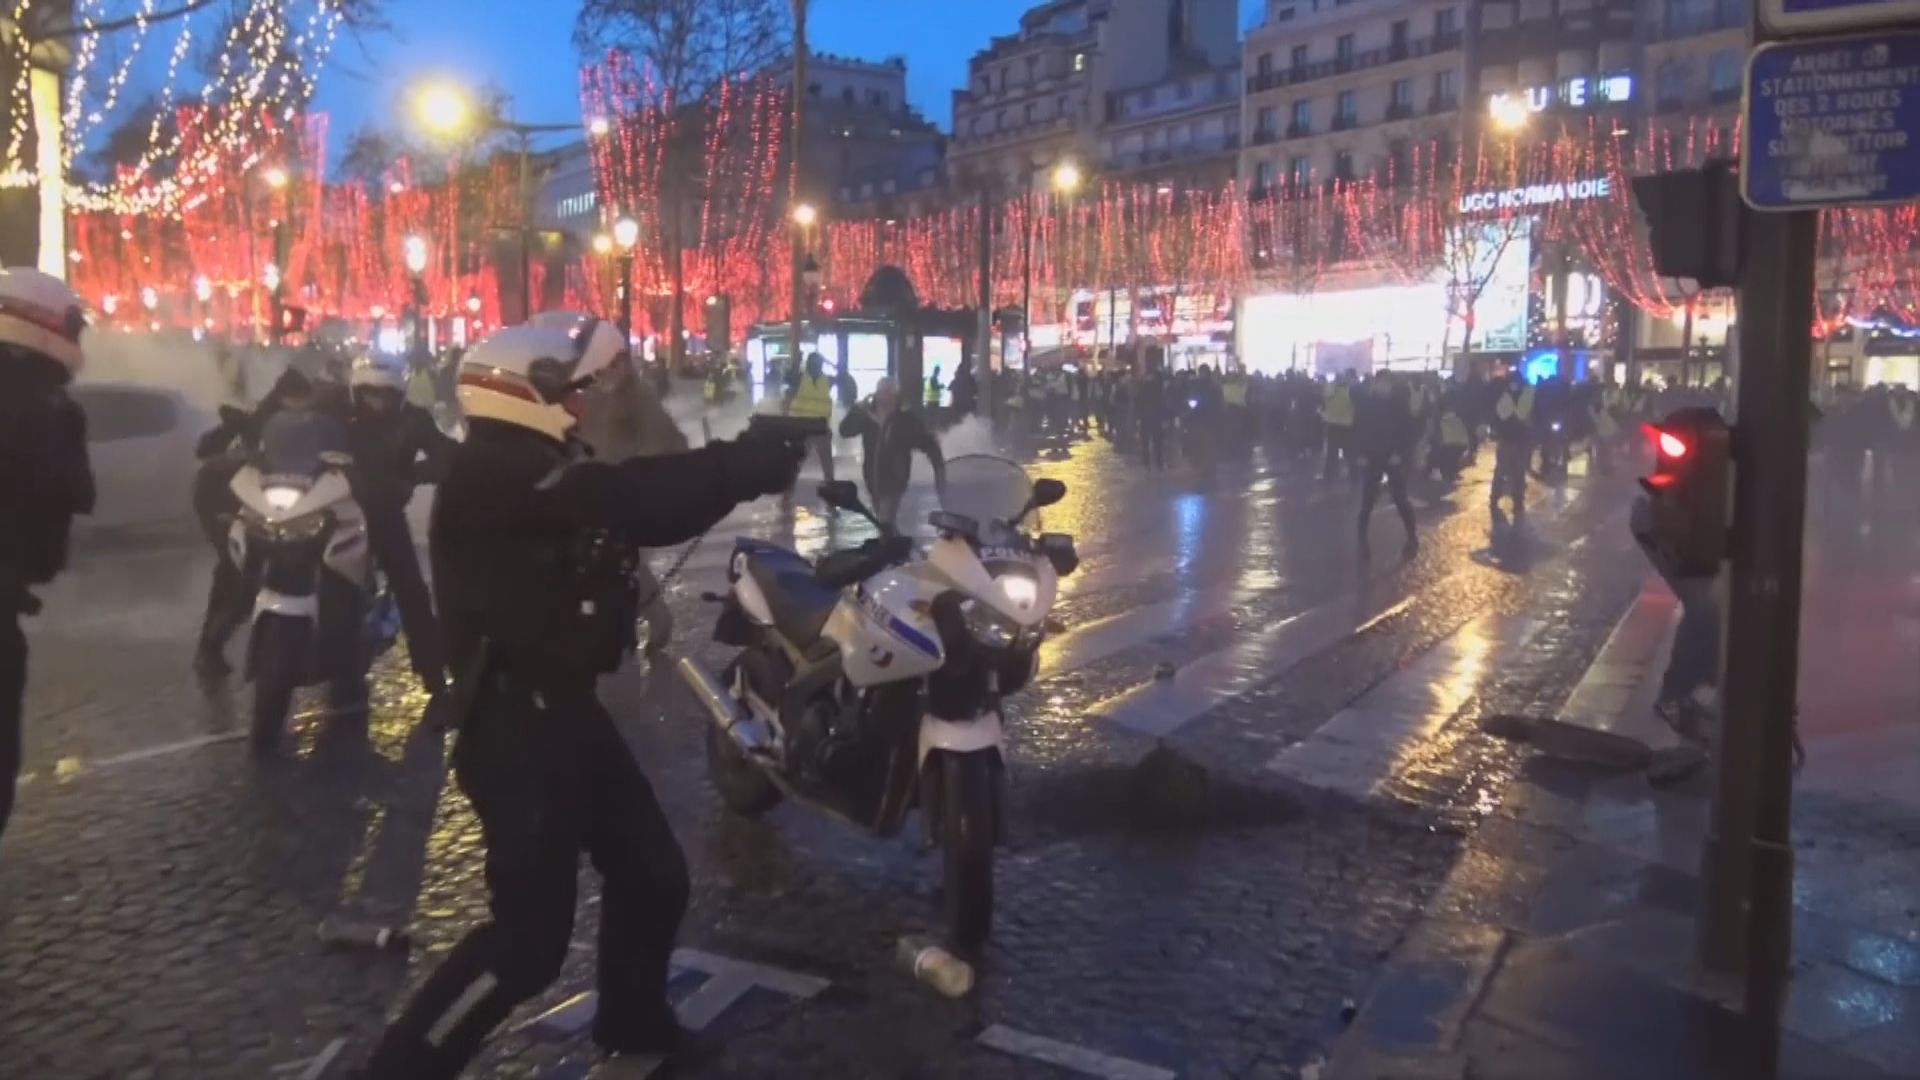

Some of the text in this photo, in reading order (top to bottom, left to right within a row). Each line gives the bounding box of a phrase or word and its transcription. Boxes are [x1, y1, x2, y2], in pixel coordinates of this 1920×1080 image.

[1760, 66, 1920, 96] STATIONNEMENT
[1774, 89, 1903, 116] DES 2 ROUES
[1459, 177, 1610, 213] UGC NORMANDIE
